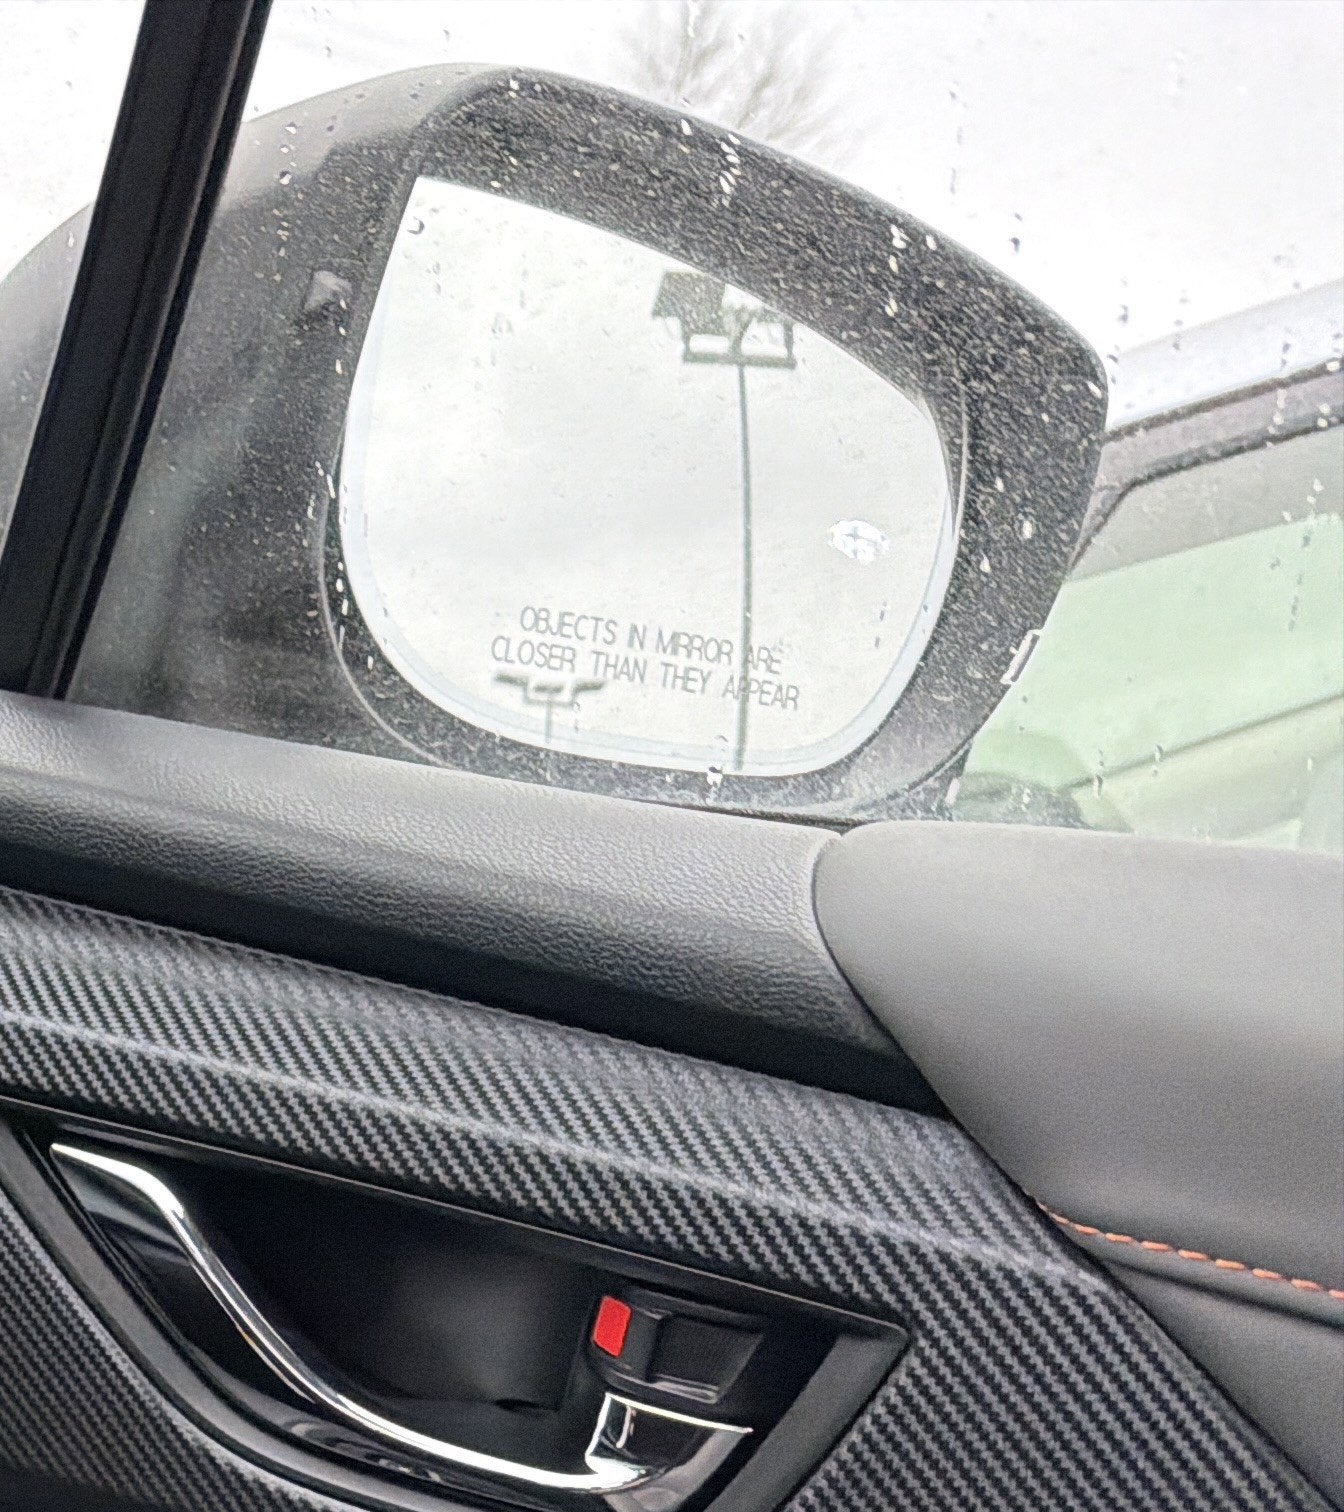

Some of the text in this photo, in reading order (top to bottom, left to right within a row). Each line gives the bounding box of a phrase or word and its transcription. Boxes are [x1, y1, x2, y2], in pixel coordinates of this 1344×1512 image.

[491, 635, 800, 711] CLOSER THAN THEY APPEAR
[519, 605, 781, 674] OBJECTS IN MIRROR ARE
